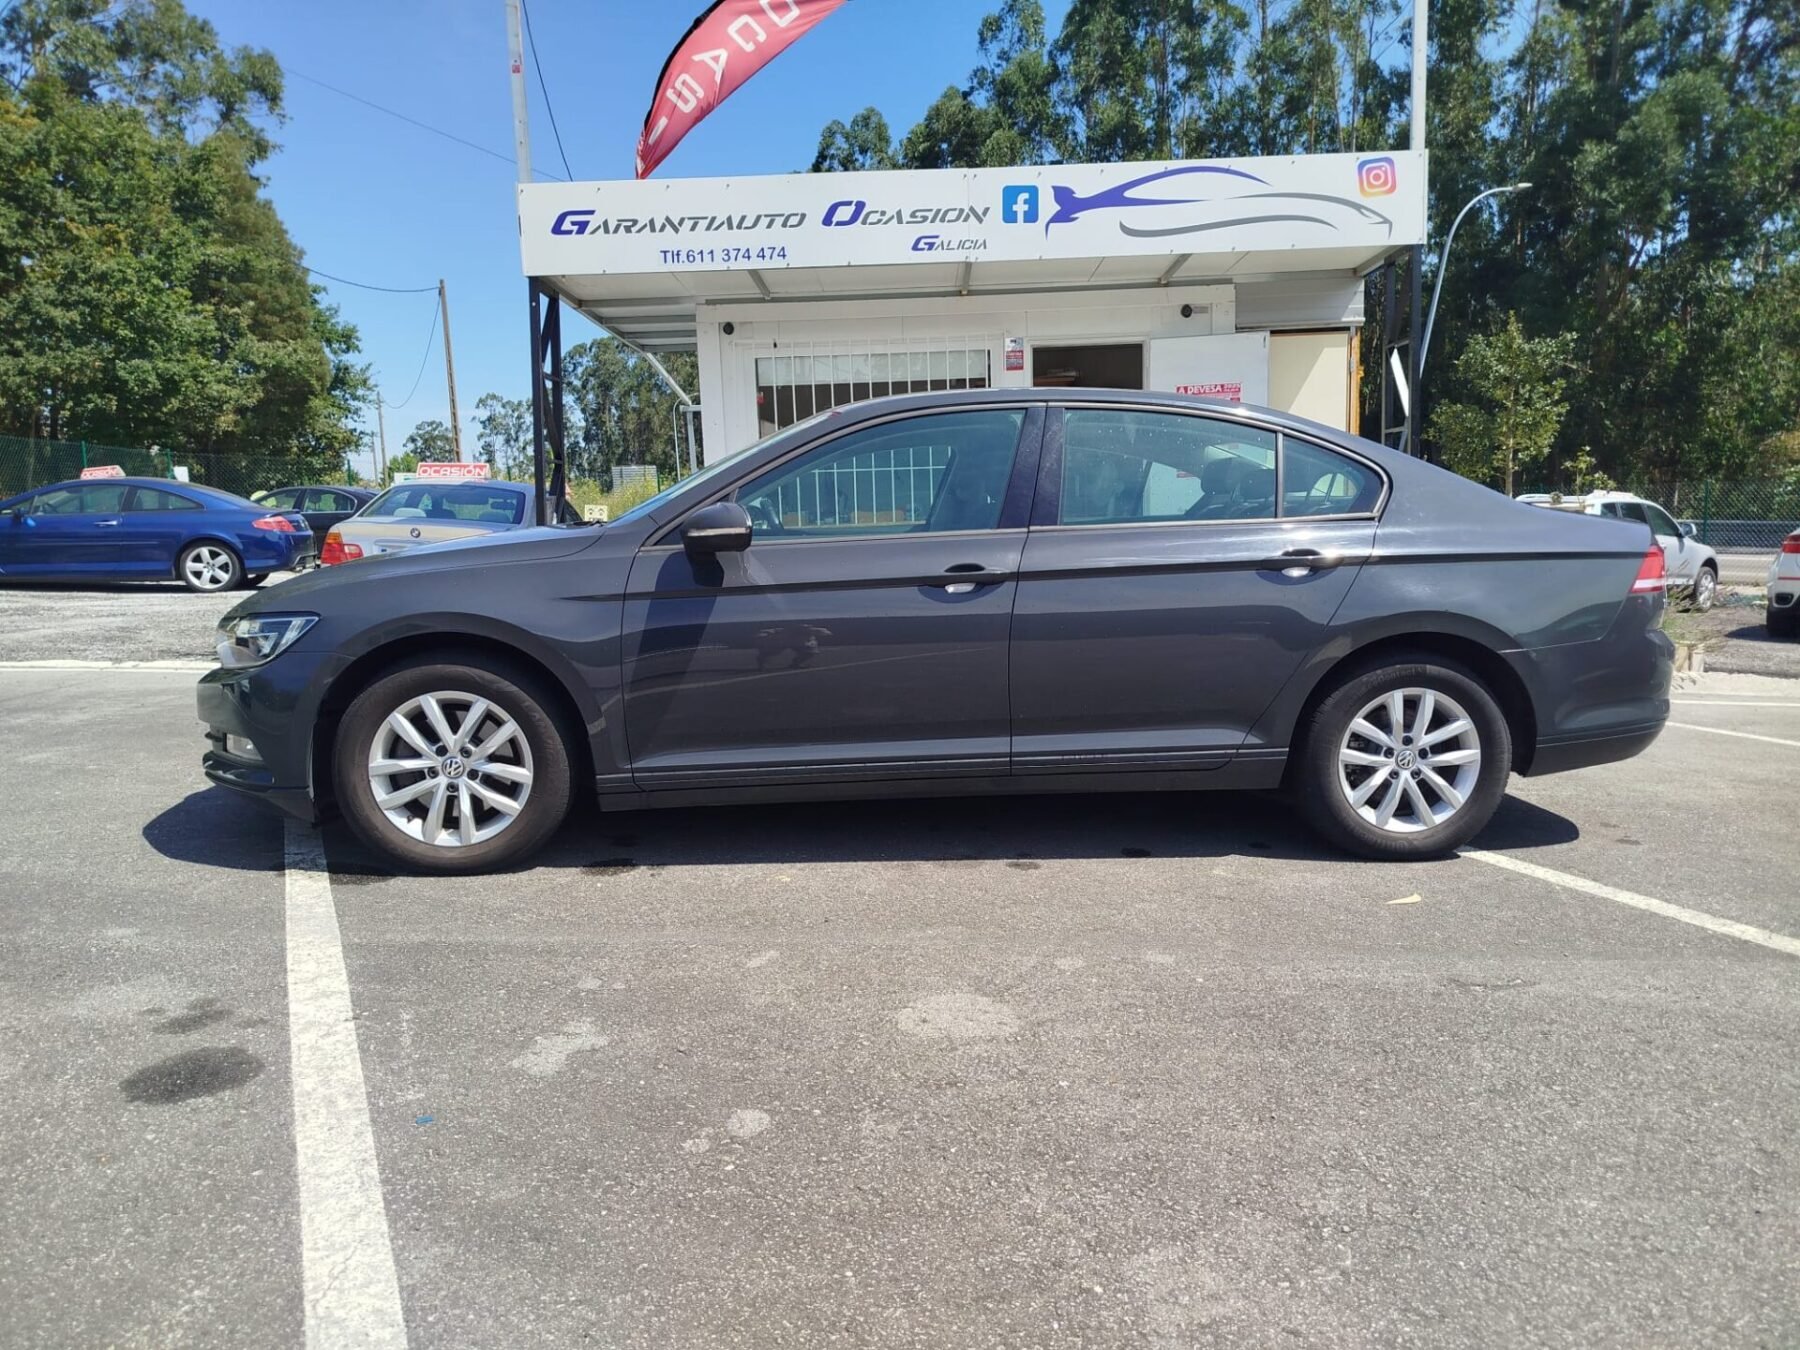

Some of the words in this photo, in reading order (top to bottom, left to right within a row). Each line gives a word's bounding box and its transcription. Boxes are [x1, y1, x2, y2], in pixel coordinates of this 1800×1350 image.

[821, 200, 991, 227] OCASION
[911, 235, 988, 252] GALICIA
[660, 247, 715, 264] Tlf.611
[721, 248, 751, 263] 374
[756, 247, 787, 261] 474
[1187, 384, 1223, 394] DEVESA
[419, 465, 486, 476] OCASIÓN
